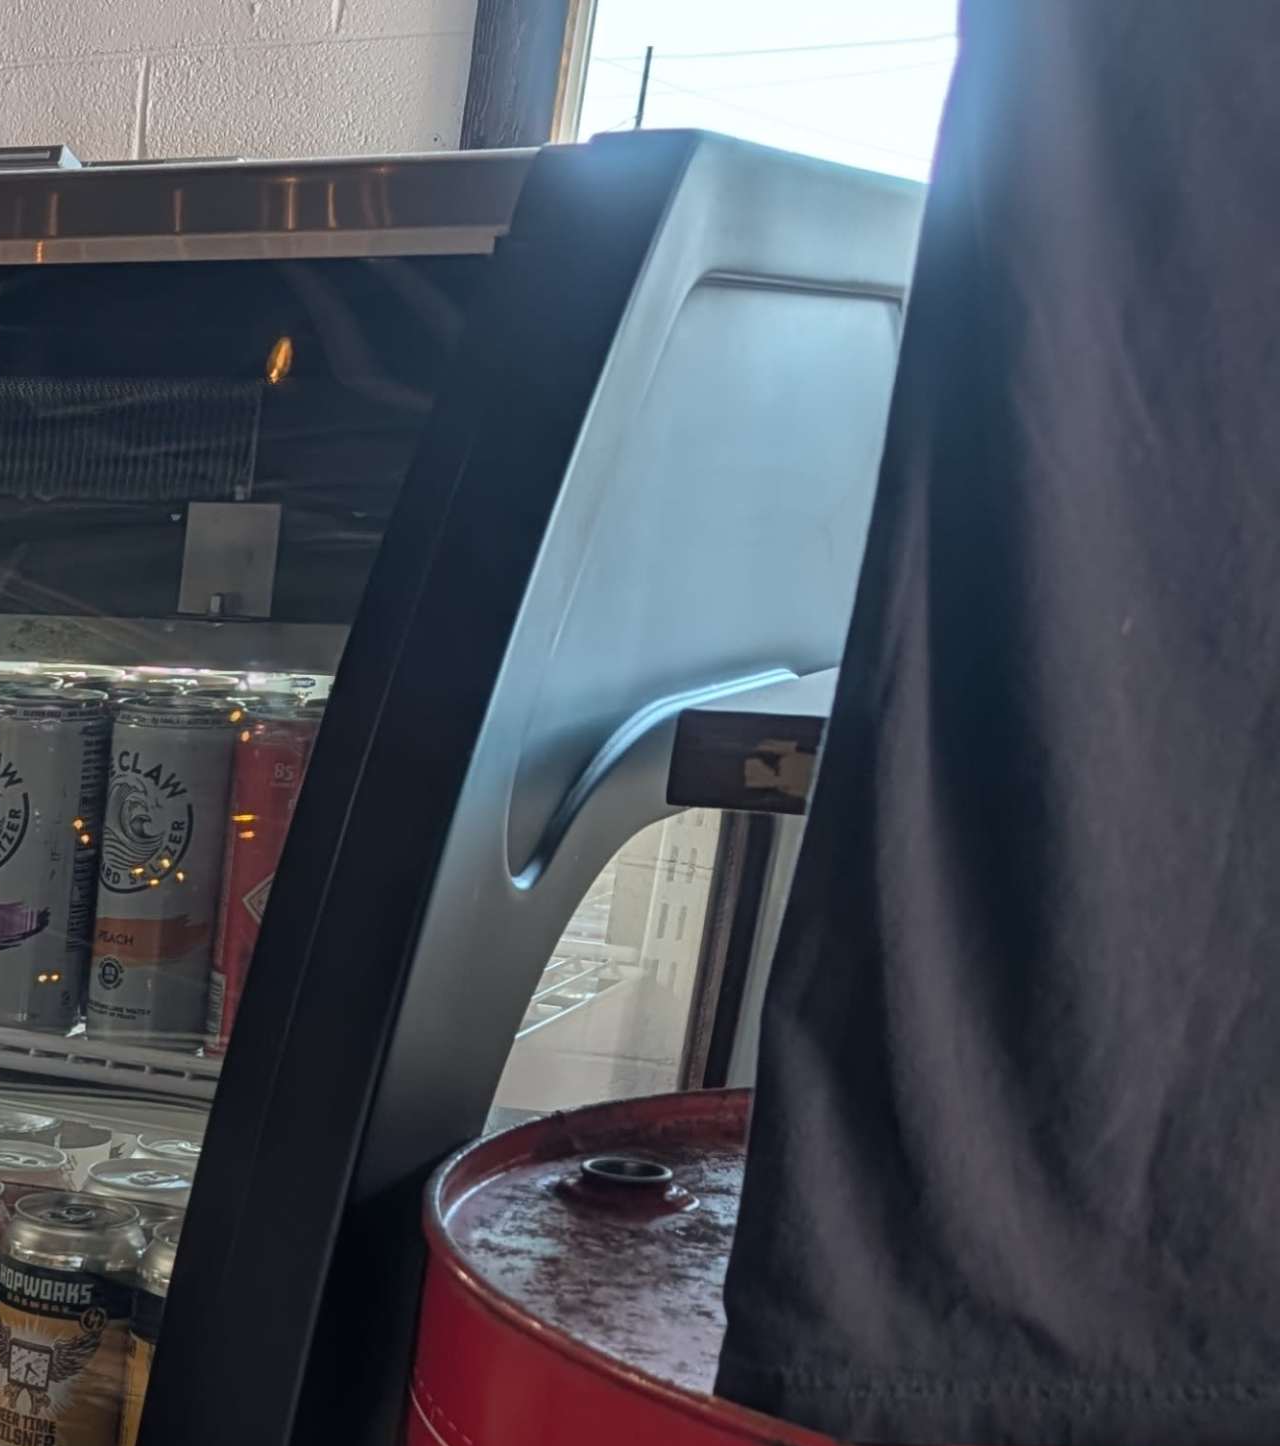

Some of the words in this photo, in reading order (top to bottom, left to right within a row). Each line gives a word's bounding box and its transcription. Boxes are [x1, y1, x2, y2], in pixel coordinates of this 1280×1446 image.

[118, 750, 187, 798] CLAW
[0, 1263, 95, 1305] HOPWORKS
[22, 1414, 57, 1435] TIME
